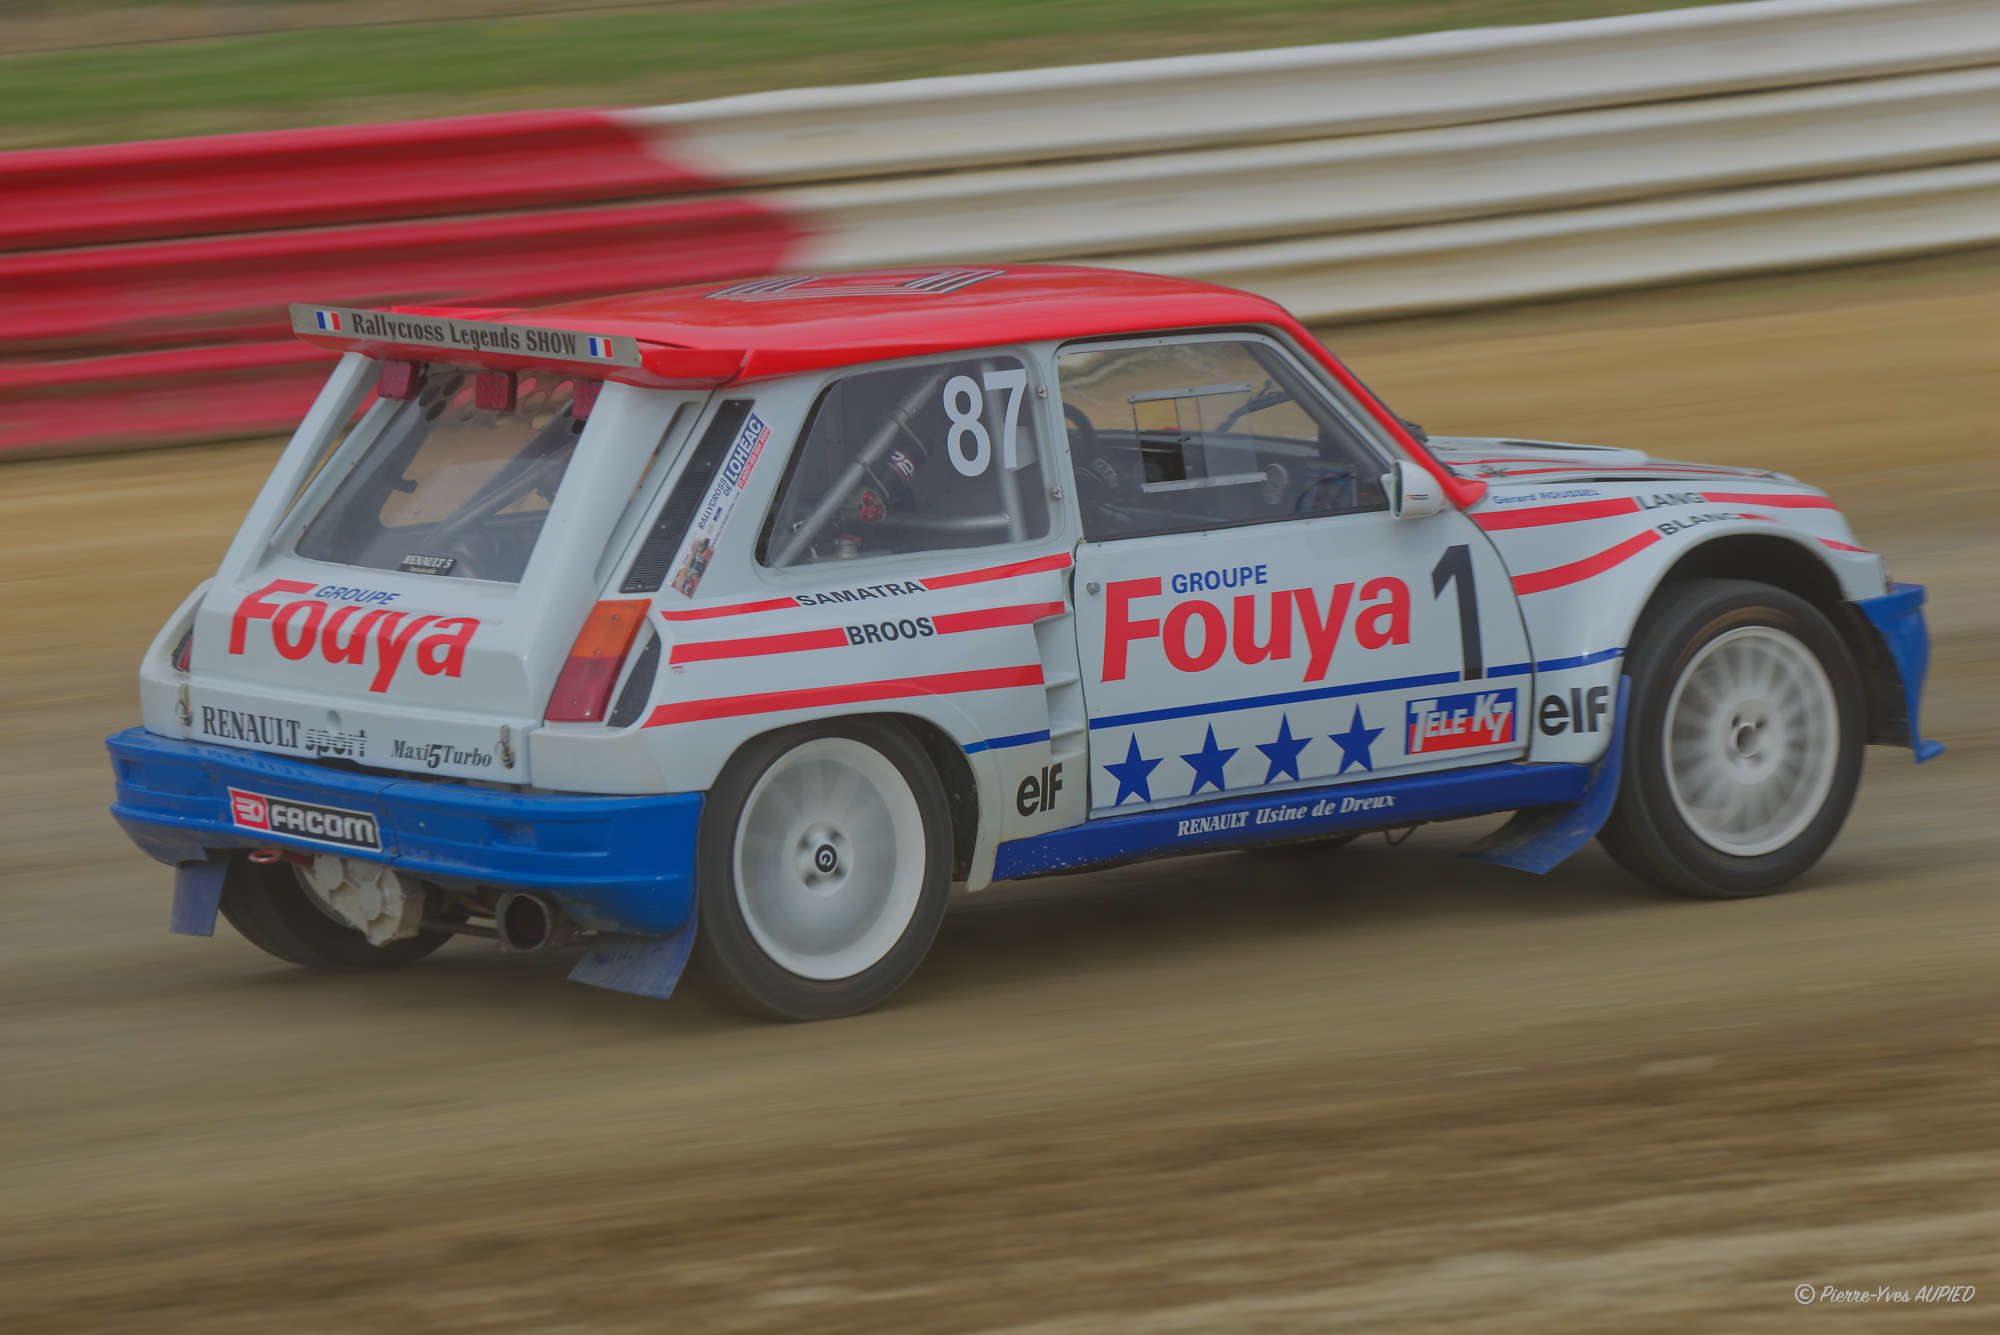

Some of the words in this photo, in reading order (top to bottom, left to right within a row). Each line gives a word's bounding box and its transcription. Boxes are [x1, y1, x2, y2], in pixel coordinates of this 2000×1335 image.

[352, 313, 444, 342] Rallycross
[449, 321, 520, 351] Legends
[526, 329, 577, 355] SHOW
[942, 368, 1026, 477] 87
[726, 418, 763, 484] LOHEAC
[698, 477, 727, 530] RALLYCROSS
[723, 486, 732, 497] DE
[1635, 492, 1705, 510] LANG
[315, 584, 400, 605] GROUPE
[796, 580, 926, 606] SAMATRA
[1171, 564, 1268, 593] GROUPE
[228, 579, 480, 693] Fouya
[846, 617, 934, 646] BROOS
[1101, 576, 1411, 683] Fouya
[1431, 544, 1482, 681] 1
[201, 705, 301, 748] RENAULT
[305, 730, 367, 758] sport
[1408, 700, 1467, 752] TELE
[1471, 693, 1513, 744] K7
[1538, 686, 1609, 736] elf
[1017, 762, 1063, 817] elf
[270, 803, 376, 843] FACOM
[1177, 811, 1248, 837] RENAULT
[1255, 806, 1307, 825] Usine
[1311, 800, 1334, 818] de
[1340, 794, 1396, 814] Dreux
